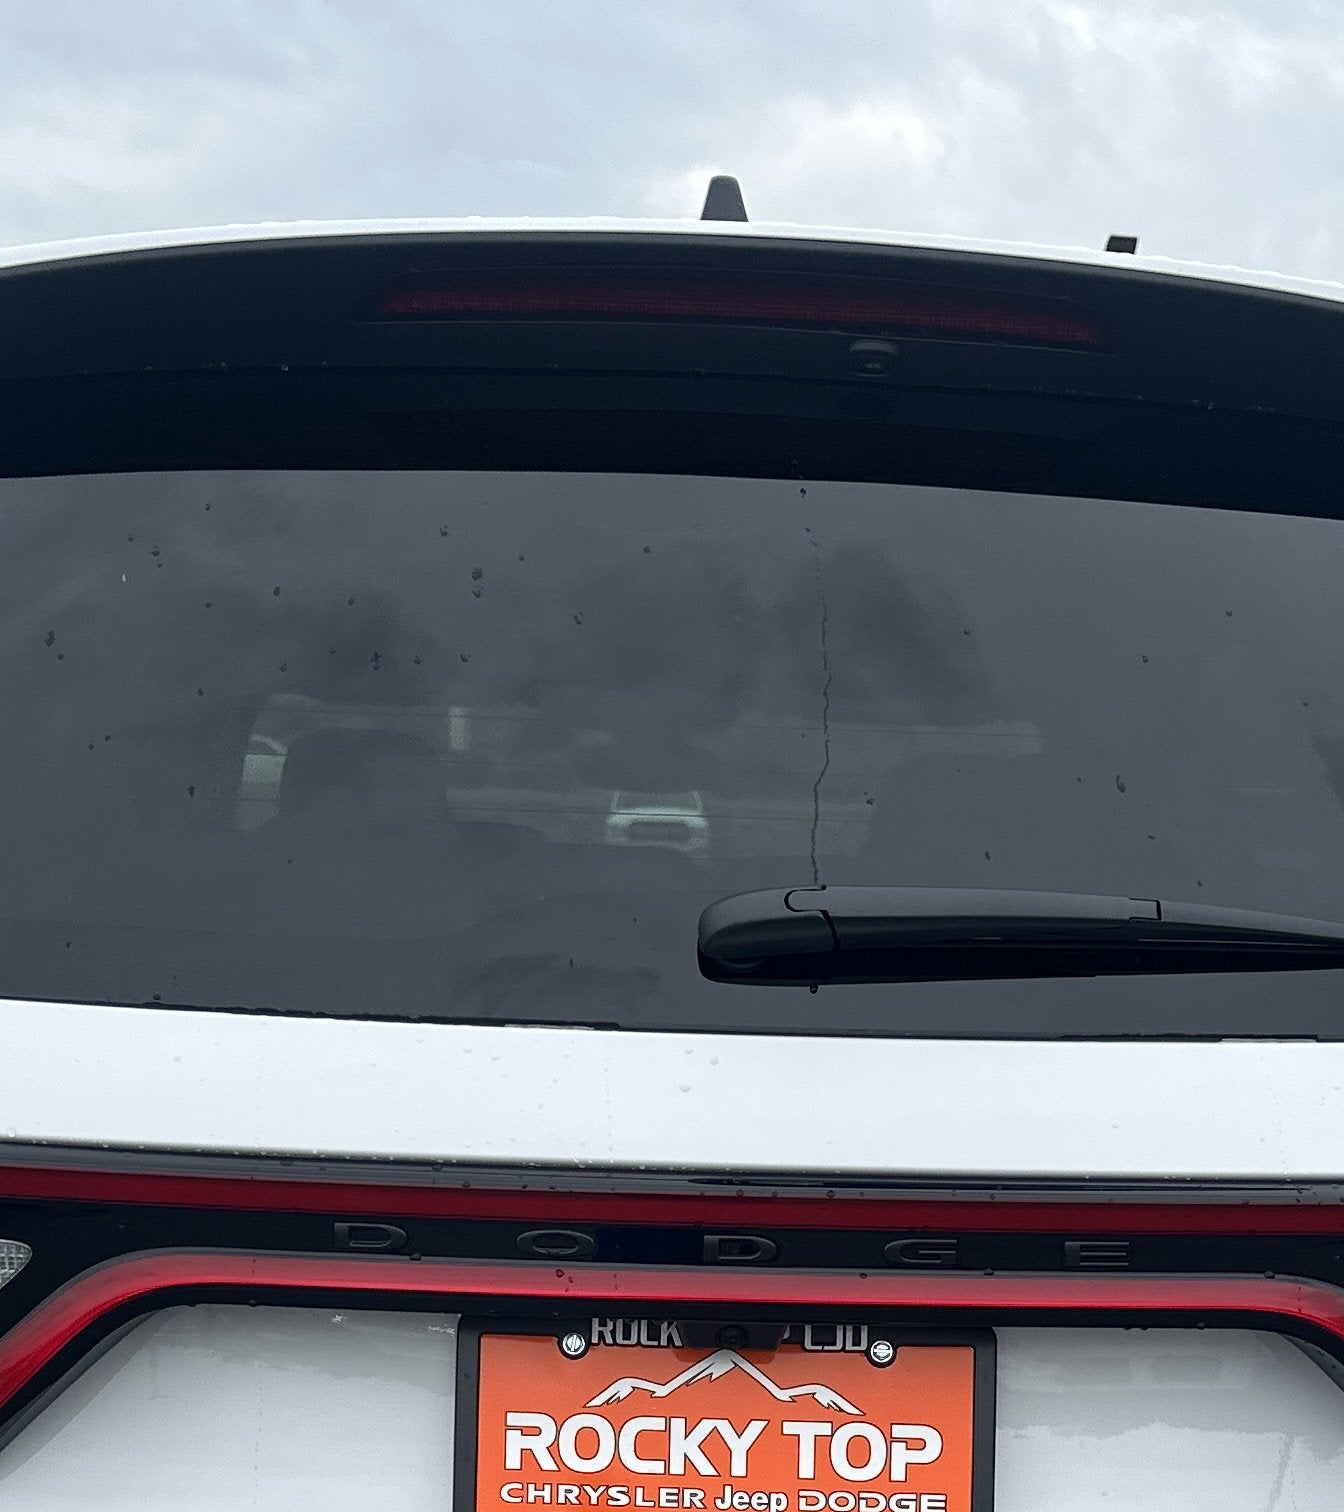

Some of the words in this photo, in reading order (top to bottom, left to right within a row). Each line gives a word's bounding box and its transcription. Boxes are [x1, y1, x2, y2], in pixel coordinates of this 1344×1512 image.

[333, 1220, 1132, 1267] DODGE
[591, 1317, 684, 1347] ROCK
[504, 1411, 771, 1478] ROCKY
[782, 1420, 944, 1483] TOP
[500, 1482, 706, 1509] CHRYSLER
